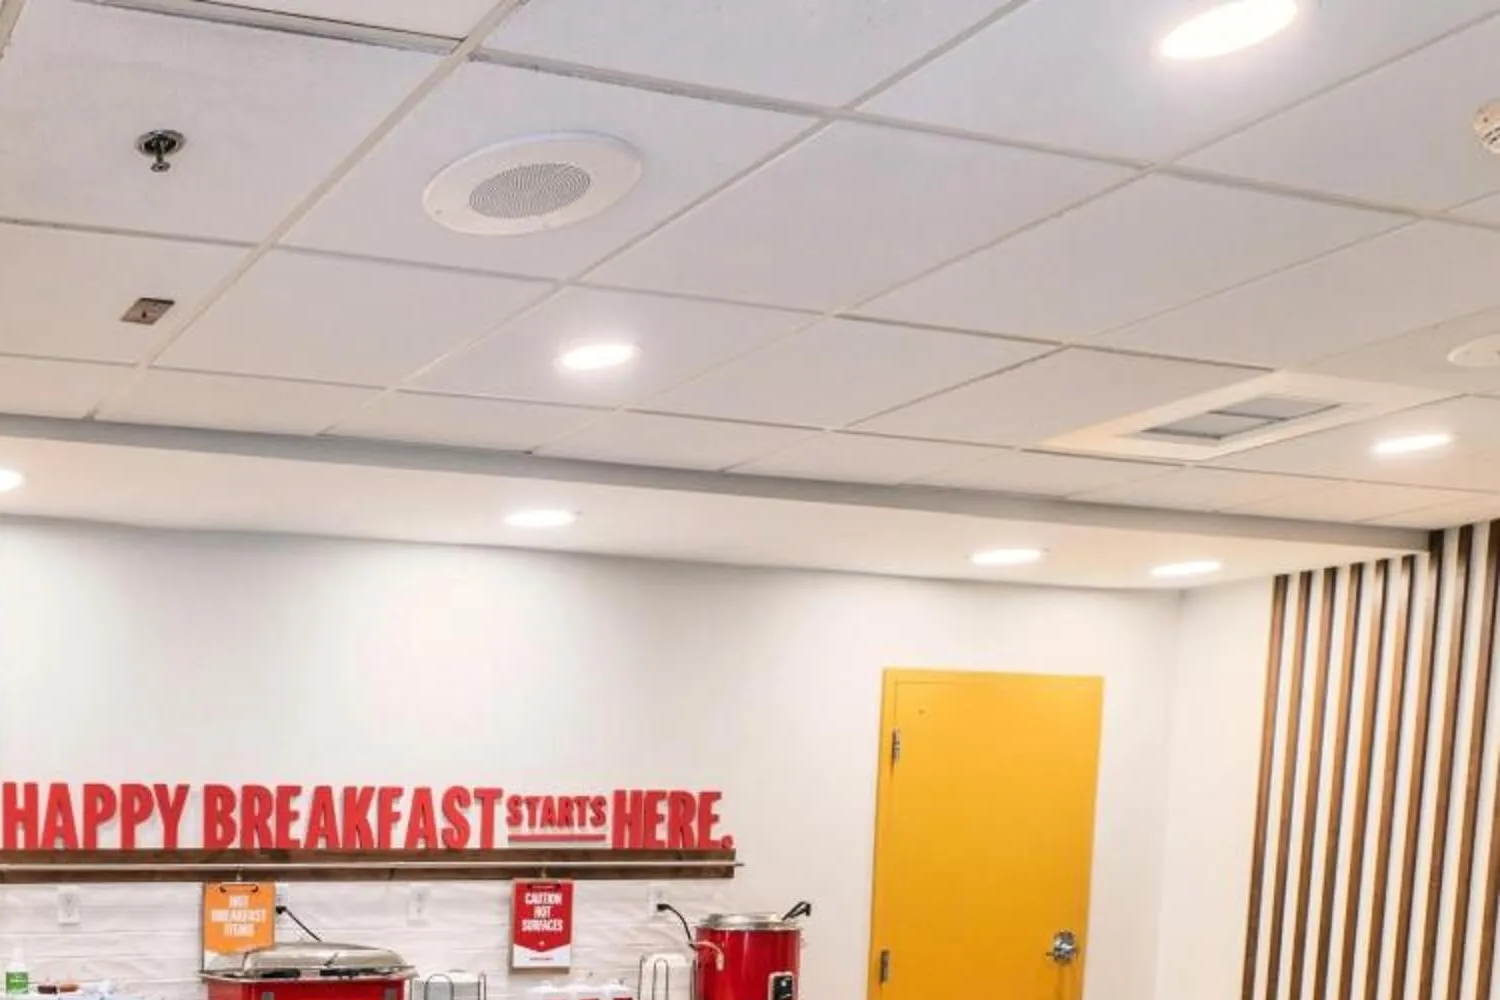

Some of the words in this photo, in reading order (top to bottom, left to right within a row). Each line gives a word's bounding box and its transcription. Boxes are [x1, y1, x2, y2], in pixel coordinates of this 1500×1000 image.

[1, 782, 190, 850] HAPPY
[203, 785, 504, 850] BREAKFAST
[506, 795, 607, 842] STARTS
[611, 789, 734, 850] HERE.
[525, 892, 563, 905] CAUTION
[211, 909, 266, 923] BREAKFAST
[533, 905, 551, 918] HOT
[521, 918, 564, 932] SURFACES
